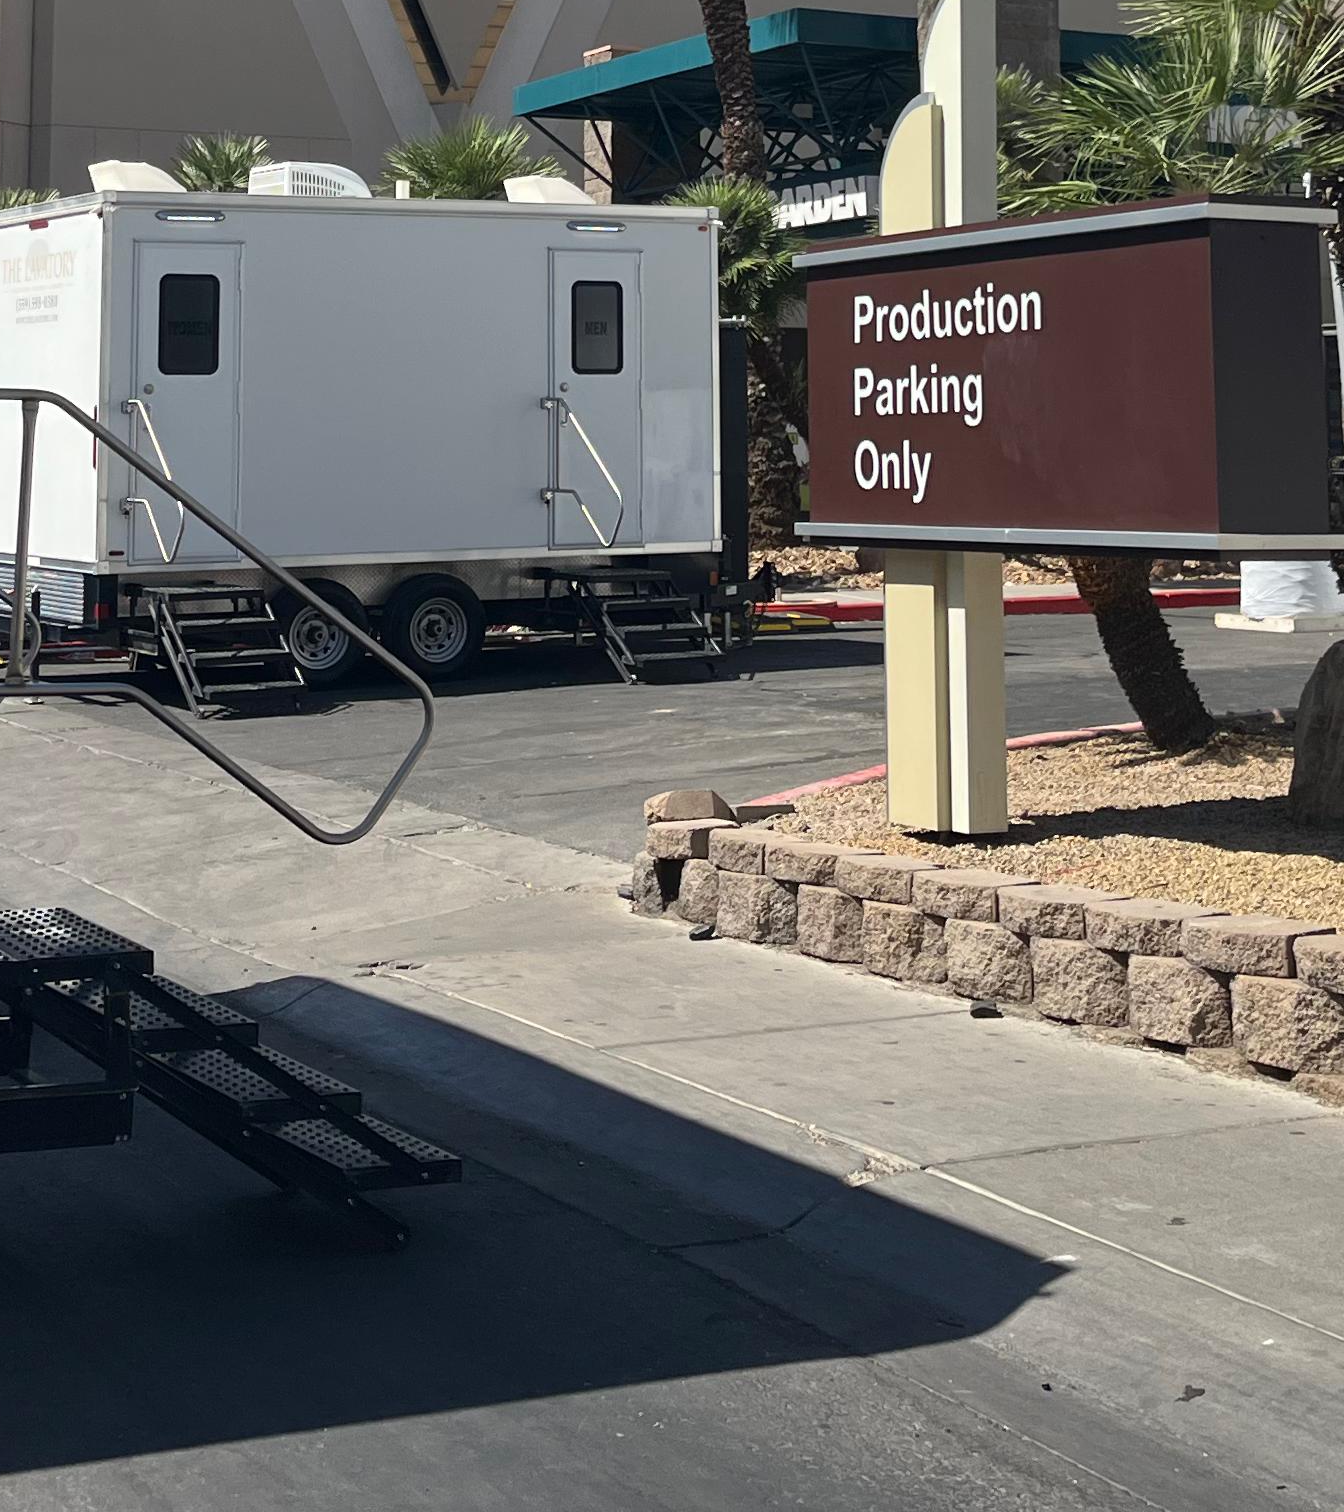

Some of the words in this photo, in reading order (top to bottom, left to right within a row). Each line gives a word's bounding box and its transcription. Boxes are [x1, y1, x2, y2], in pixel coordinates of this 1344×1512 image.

[768, 176, 868, 229] ARDEN
[853, 283, 1043, 344] Production
[853, 363, 985, 427] Parking
[854, 439, 933, 504] Only
